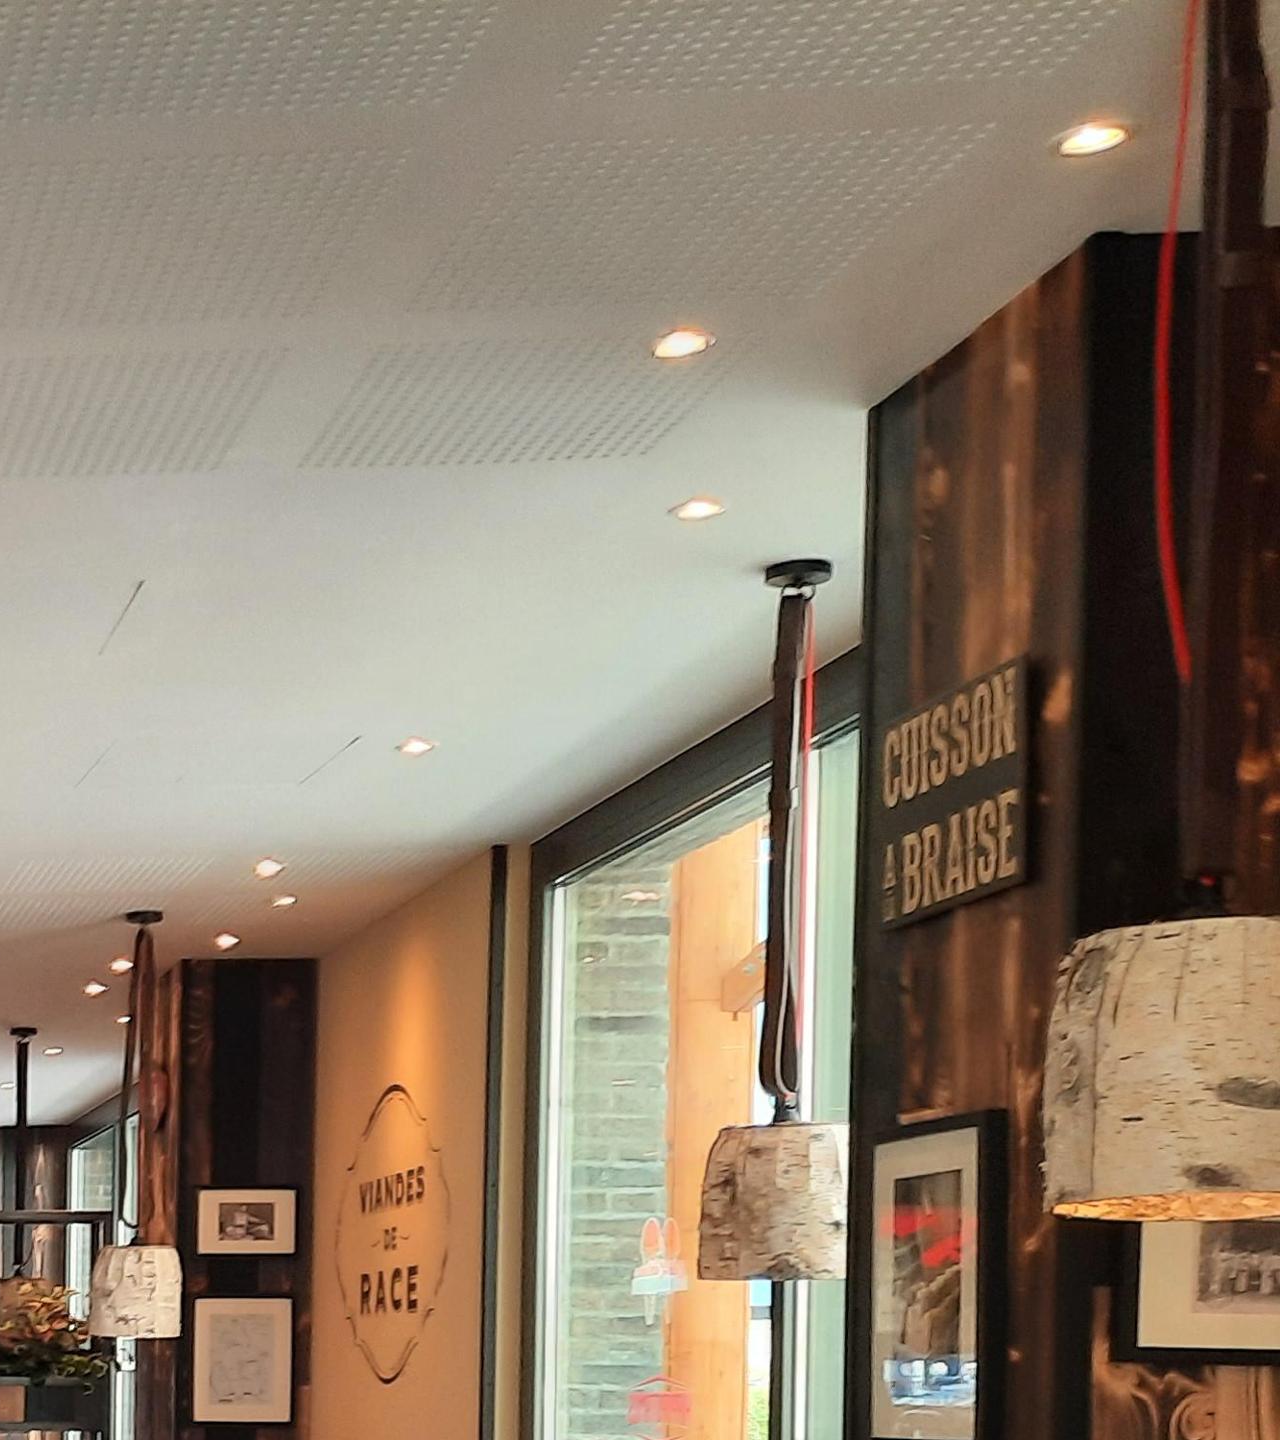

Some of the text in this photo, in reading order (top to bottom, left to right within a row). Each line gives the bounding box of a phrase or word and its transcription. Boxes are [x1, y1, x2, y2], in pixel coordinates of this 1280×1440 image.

[882, 667, 1017, 809] CUISSON
[902, 788, 1019, 914] BRAISE
[359, 1166, 425, 1214] VIANDES
[383, 1227, 397, 1250] DE
[360, 1266, 419, 1314] RACE
